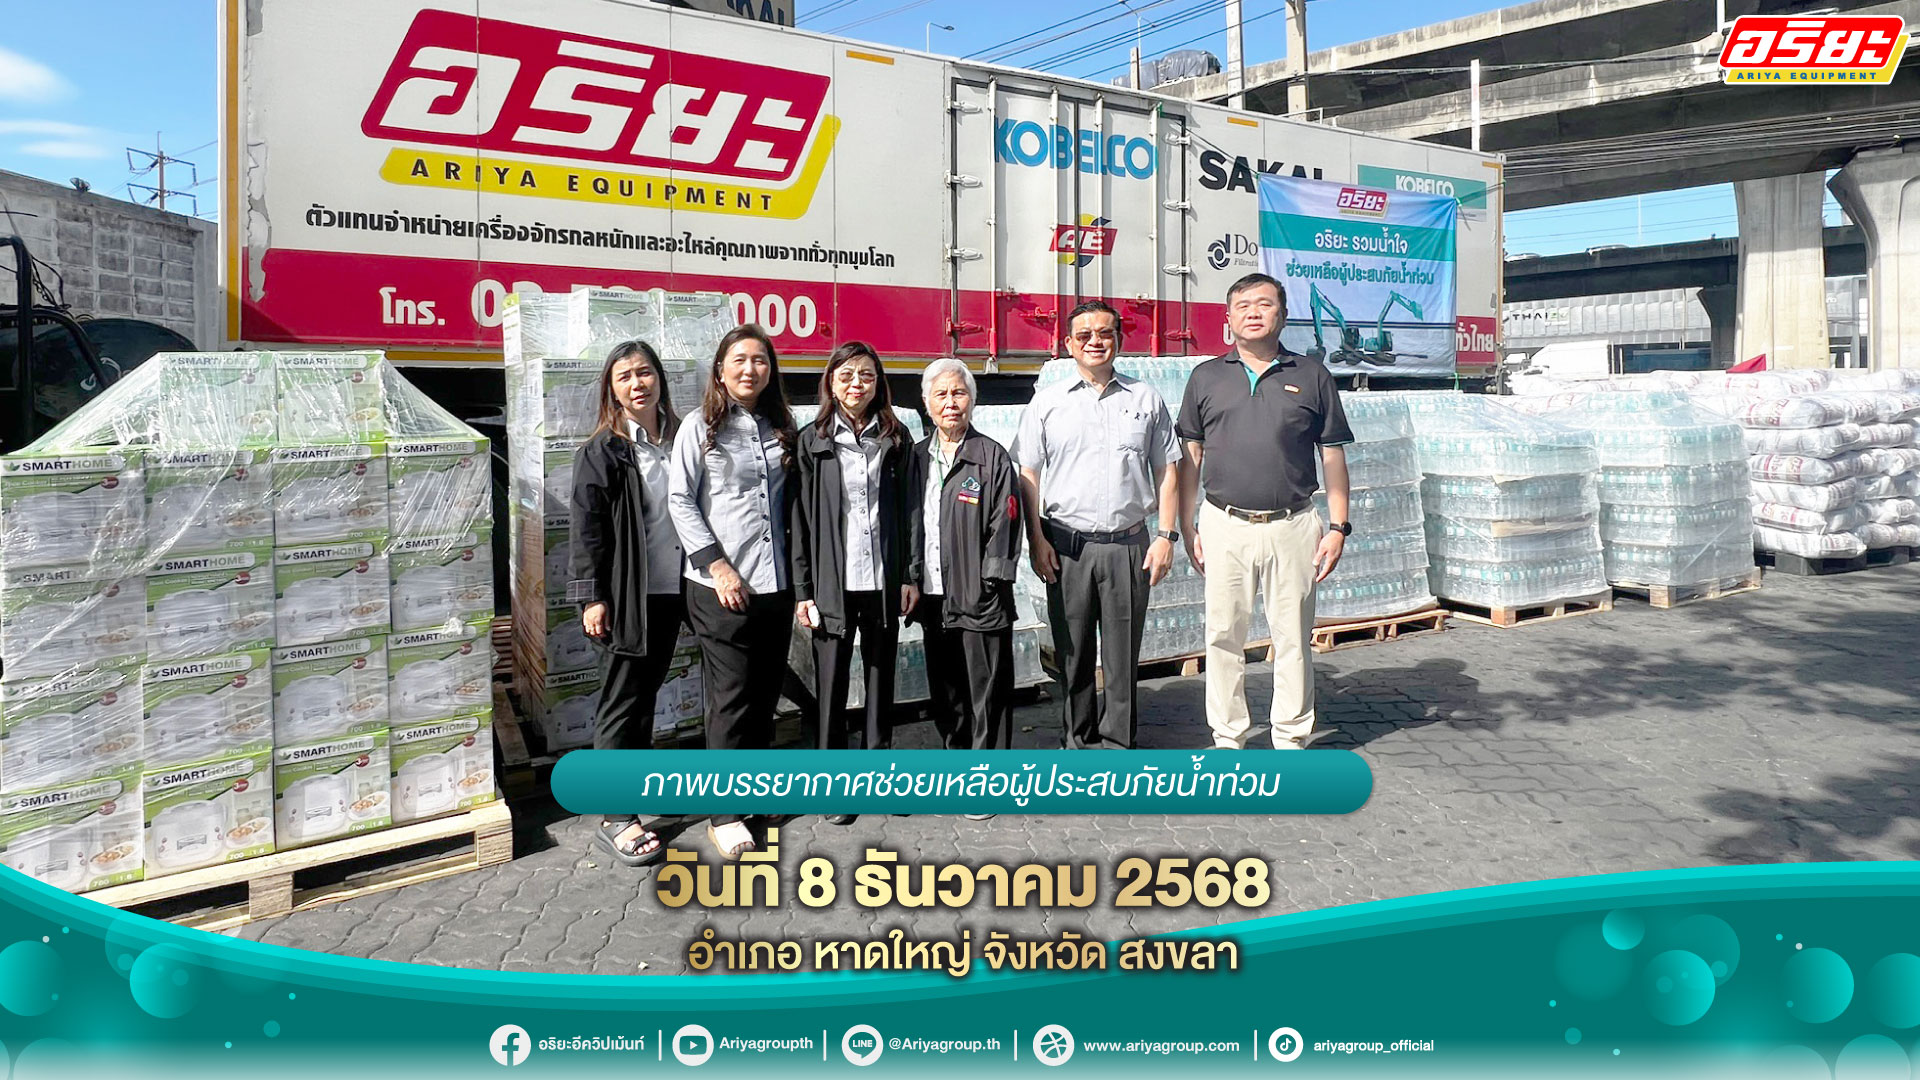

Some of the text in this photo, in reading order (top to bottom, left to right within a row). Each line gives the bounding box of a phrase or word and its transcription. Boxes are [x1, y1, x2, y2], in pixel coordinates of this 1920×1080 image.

[379, 39, 806, 173] อริยะ
[994, 115, 1158, 180] KOBELCO
[411, 158, 772, 211] ARIYA EQUIPMENT
[1338, 190, 1385, 211] อริยะ
[1314, 227, 1409, 255] อริยะ รวมน้ำใจ
[1286, 258, 1435, 286] ช่วยเหลือผู้ประสบภัยน้ำท่วม
[379, 286, 446, 326] โทร.
[403, 443, 468, 453] SMARTHOME
[22, 458, 113, 472] SMARTHOME
[165, 555, 245, 570] SMARTHOME
[292, 545, 365, 560] SMARTHOME
[290, 642, 362, 660] SMARTHOME
[161, 658, 242, 677] SMARTHOME
[406, 721, 472, 740] SMARTHOME
[293, 740, 366, 760] SMARTHOME
[20, 784, 112, 807] SMARTHOME
